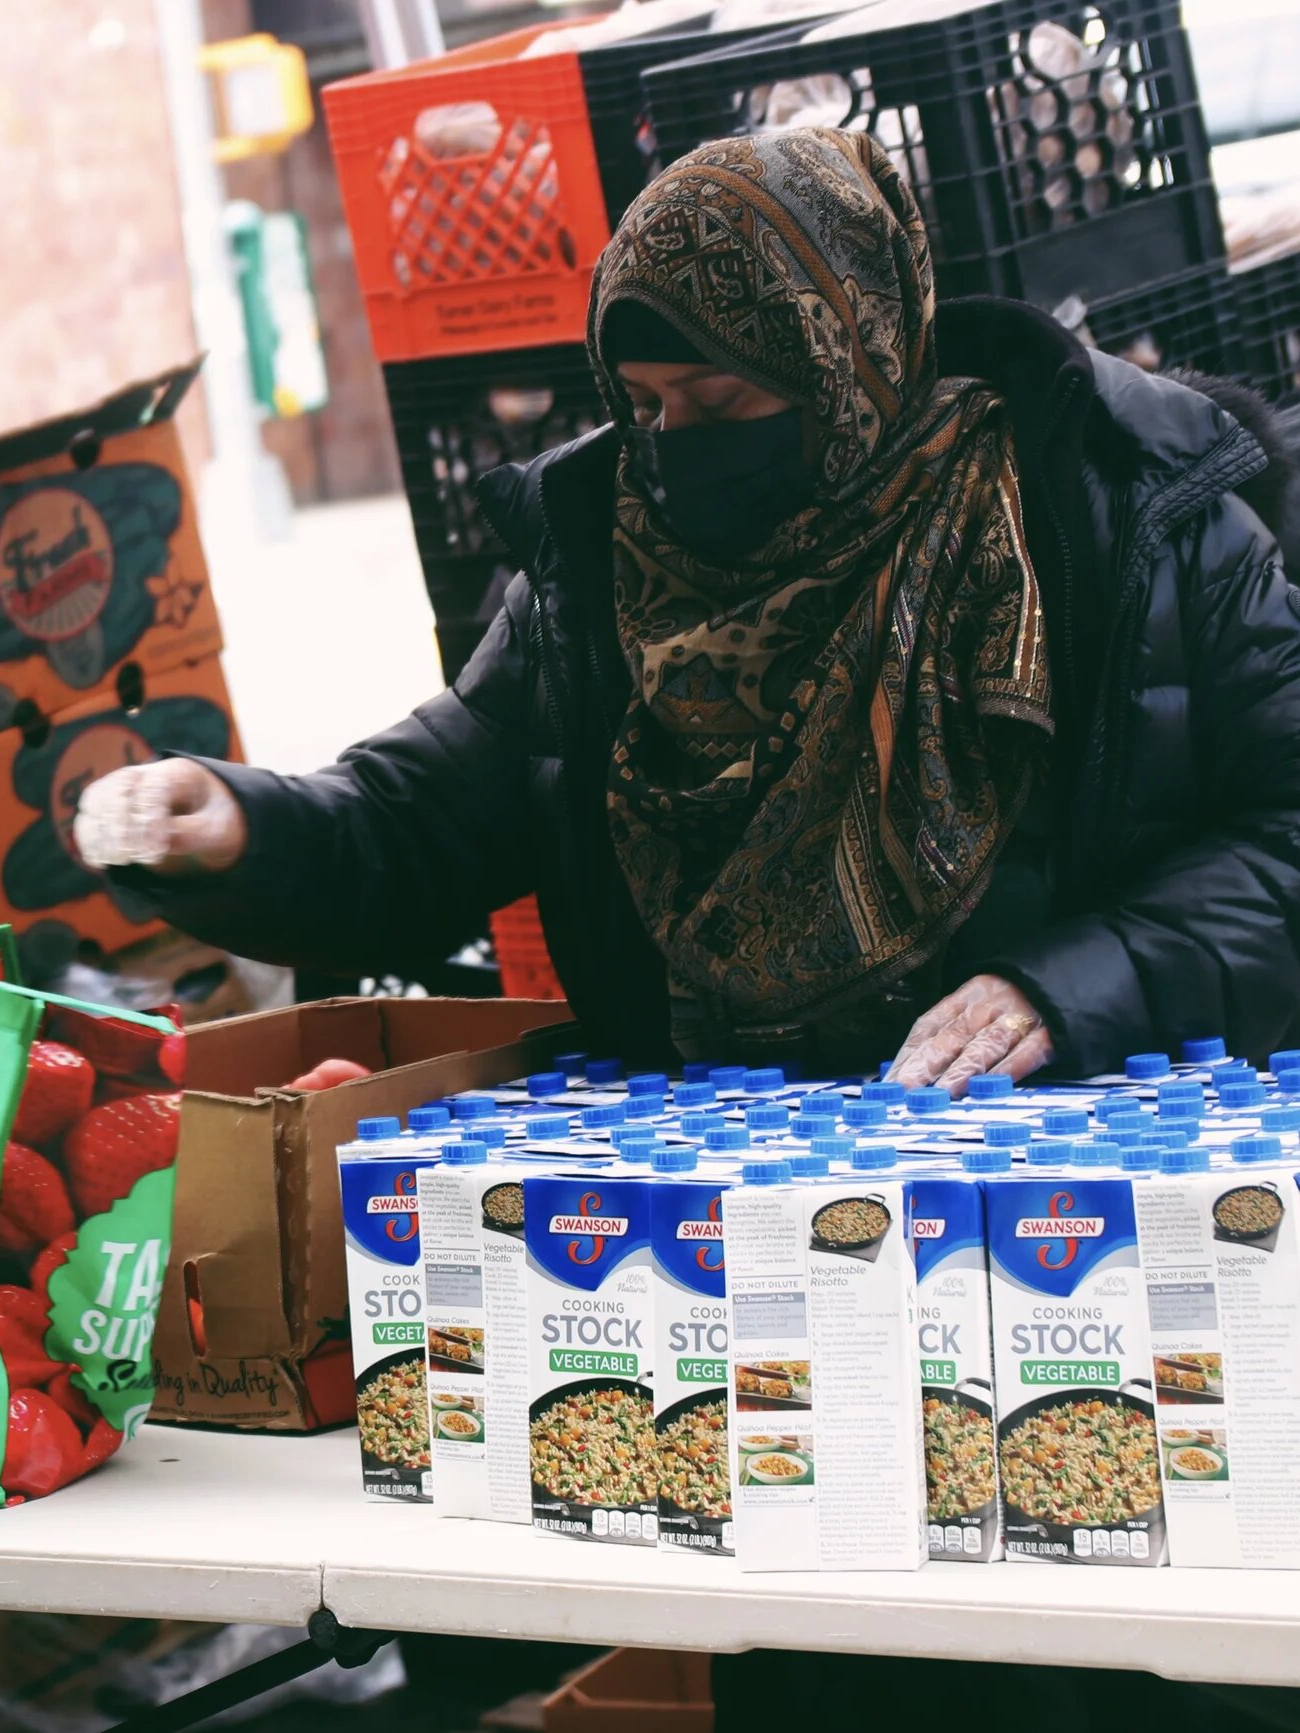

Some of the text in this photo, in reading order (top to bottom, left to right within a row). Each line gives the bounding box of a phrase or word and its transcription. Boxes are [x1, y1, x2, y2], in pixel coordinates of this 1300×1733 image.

[372, 1198, 418, 1211] SWANS
[555, 1218, 621, 1233] SWANSON
[1022, 1220, 1096, 1234] SWANSON
[484, 1242, 524, 1254] Vegetable
[484, 1253, 512, 1263] Risotto
[1217, 1255, 1267, 1267] Vegetable
[810, 1266, 867, 1277] Vegetable
[1218, 1267, 1252, 1277] Risotto
[810, 1278, 848, 1287] Risotto
[562, 1299, 625, 1314] COOKING
[1033, 1307, 1103, 1319] COOKING
[541, 1314, 643, 1348] STOCK
[1011, 1323, 1126, 1355] STOCK
[734, 1351, 763, 1359] Quinoa
[552, 1353, 634, 1373] VEGETABLE
[1024, 1364, 1116, 1381] VEGETABLE
[199, 1359, 277, 1406] Quality
[1078, 1532, 1087, 1543] 15
